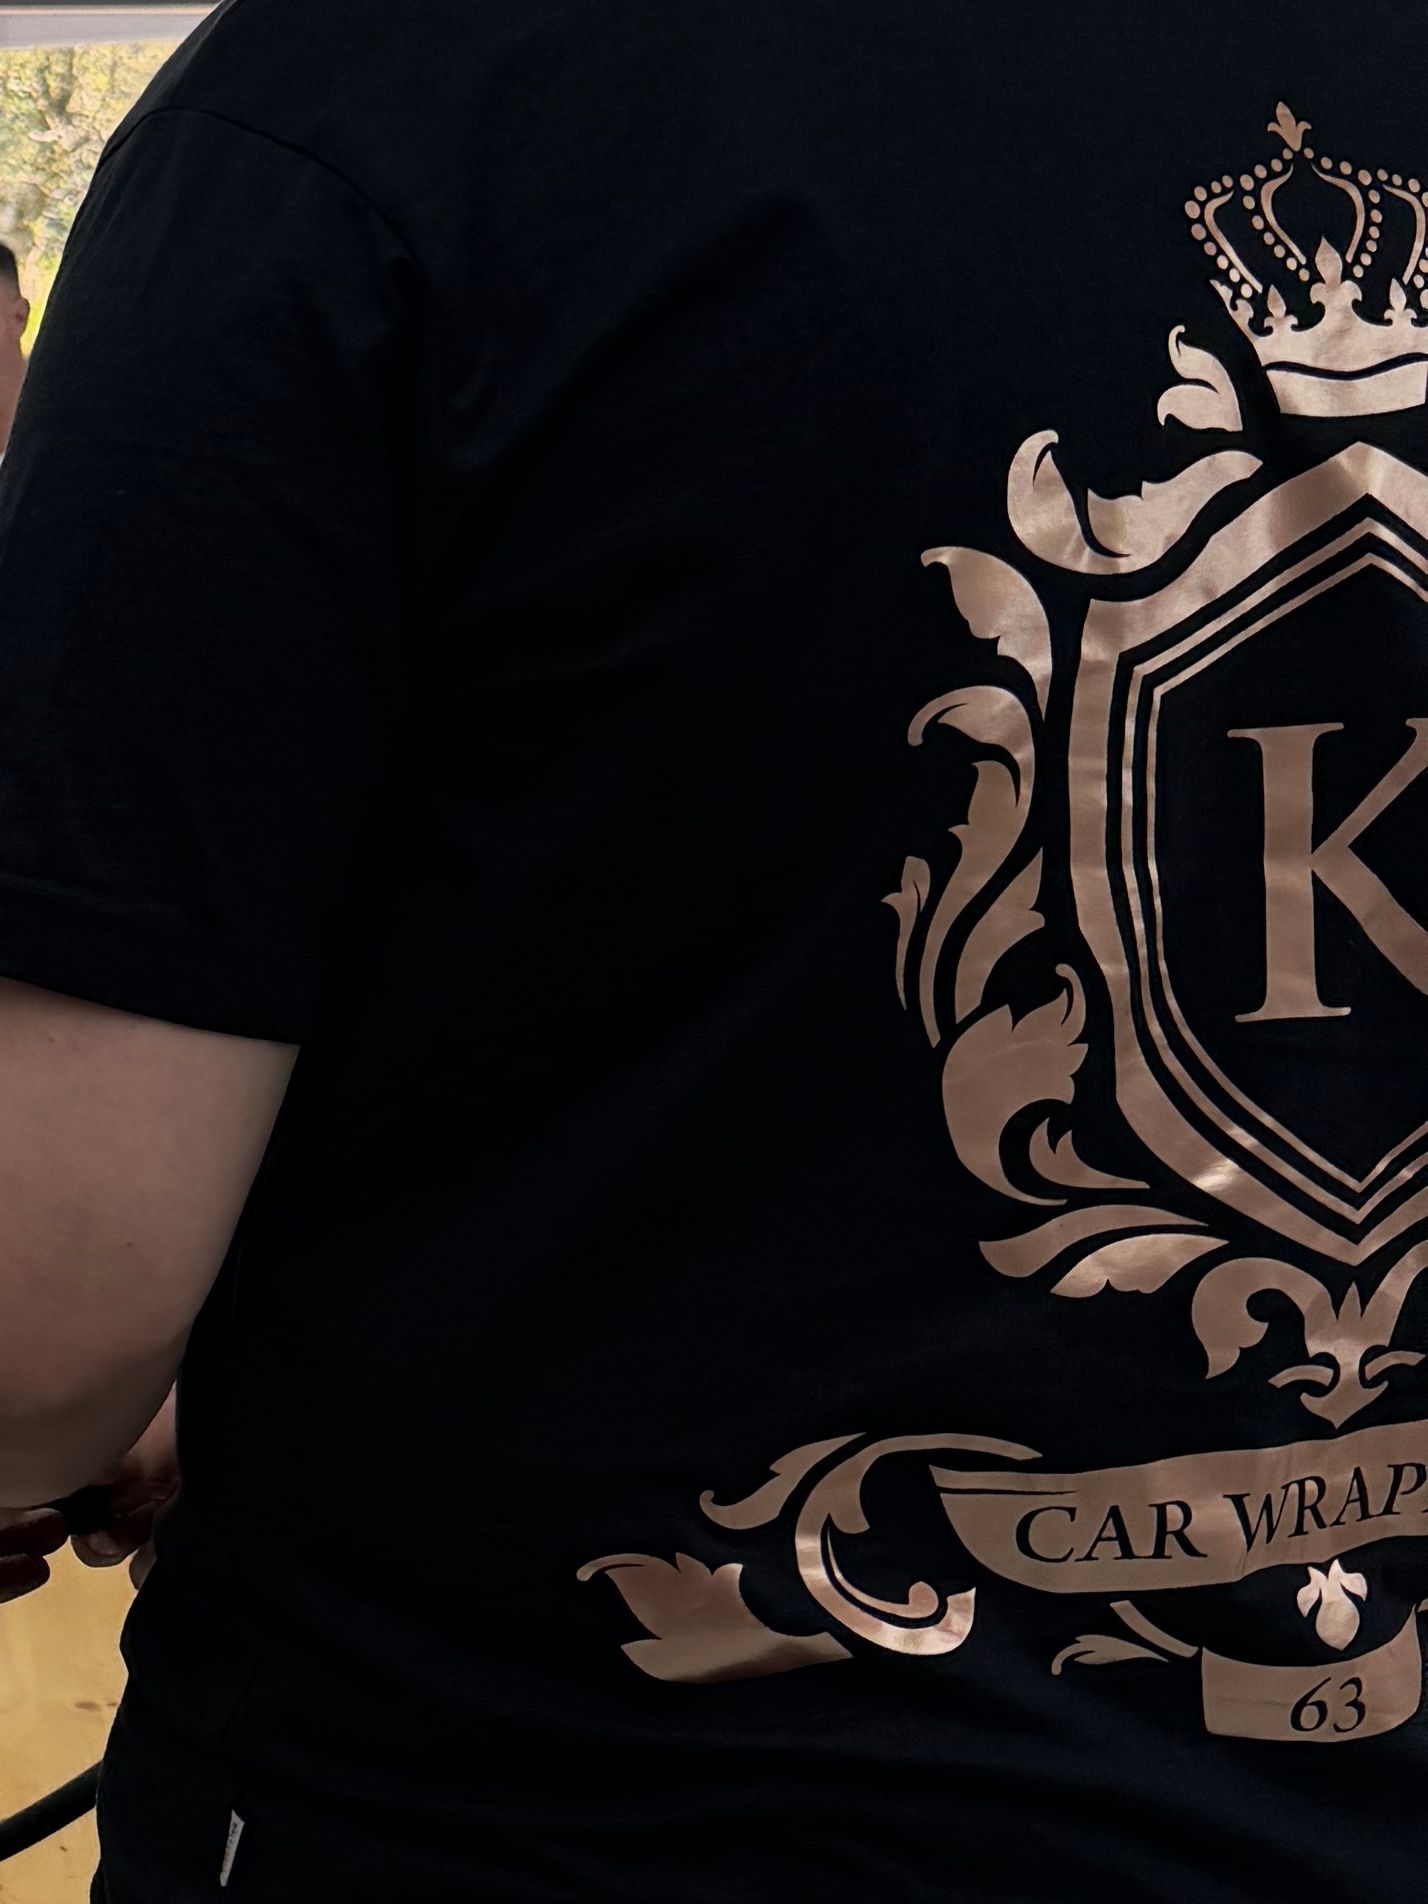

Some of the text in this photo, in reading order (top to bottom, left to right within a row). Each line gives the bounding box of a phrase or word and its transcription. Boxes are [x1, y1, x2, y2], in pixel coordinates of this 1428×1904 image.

[1227, 719, 1428, 1023] K
[1015, 1462, 1428, 1565] CAR WRAP
[1290, 1675, 1367, 1734] 63
